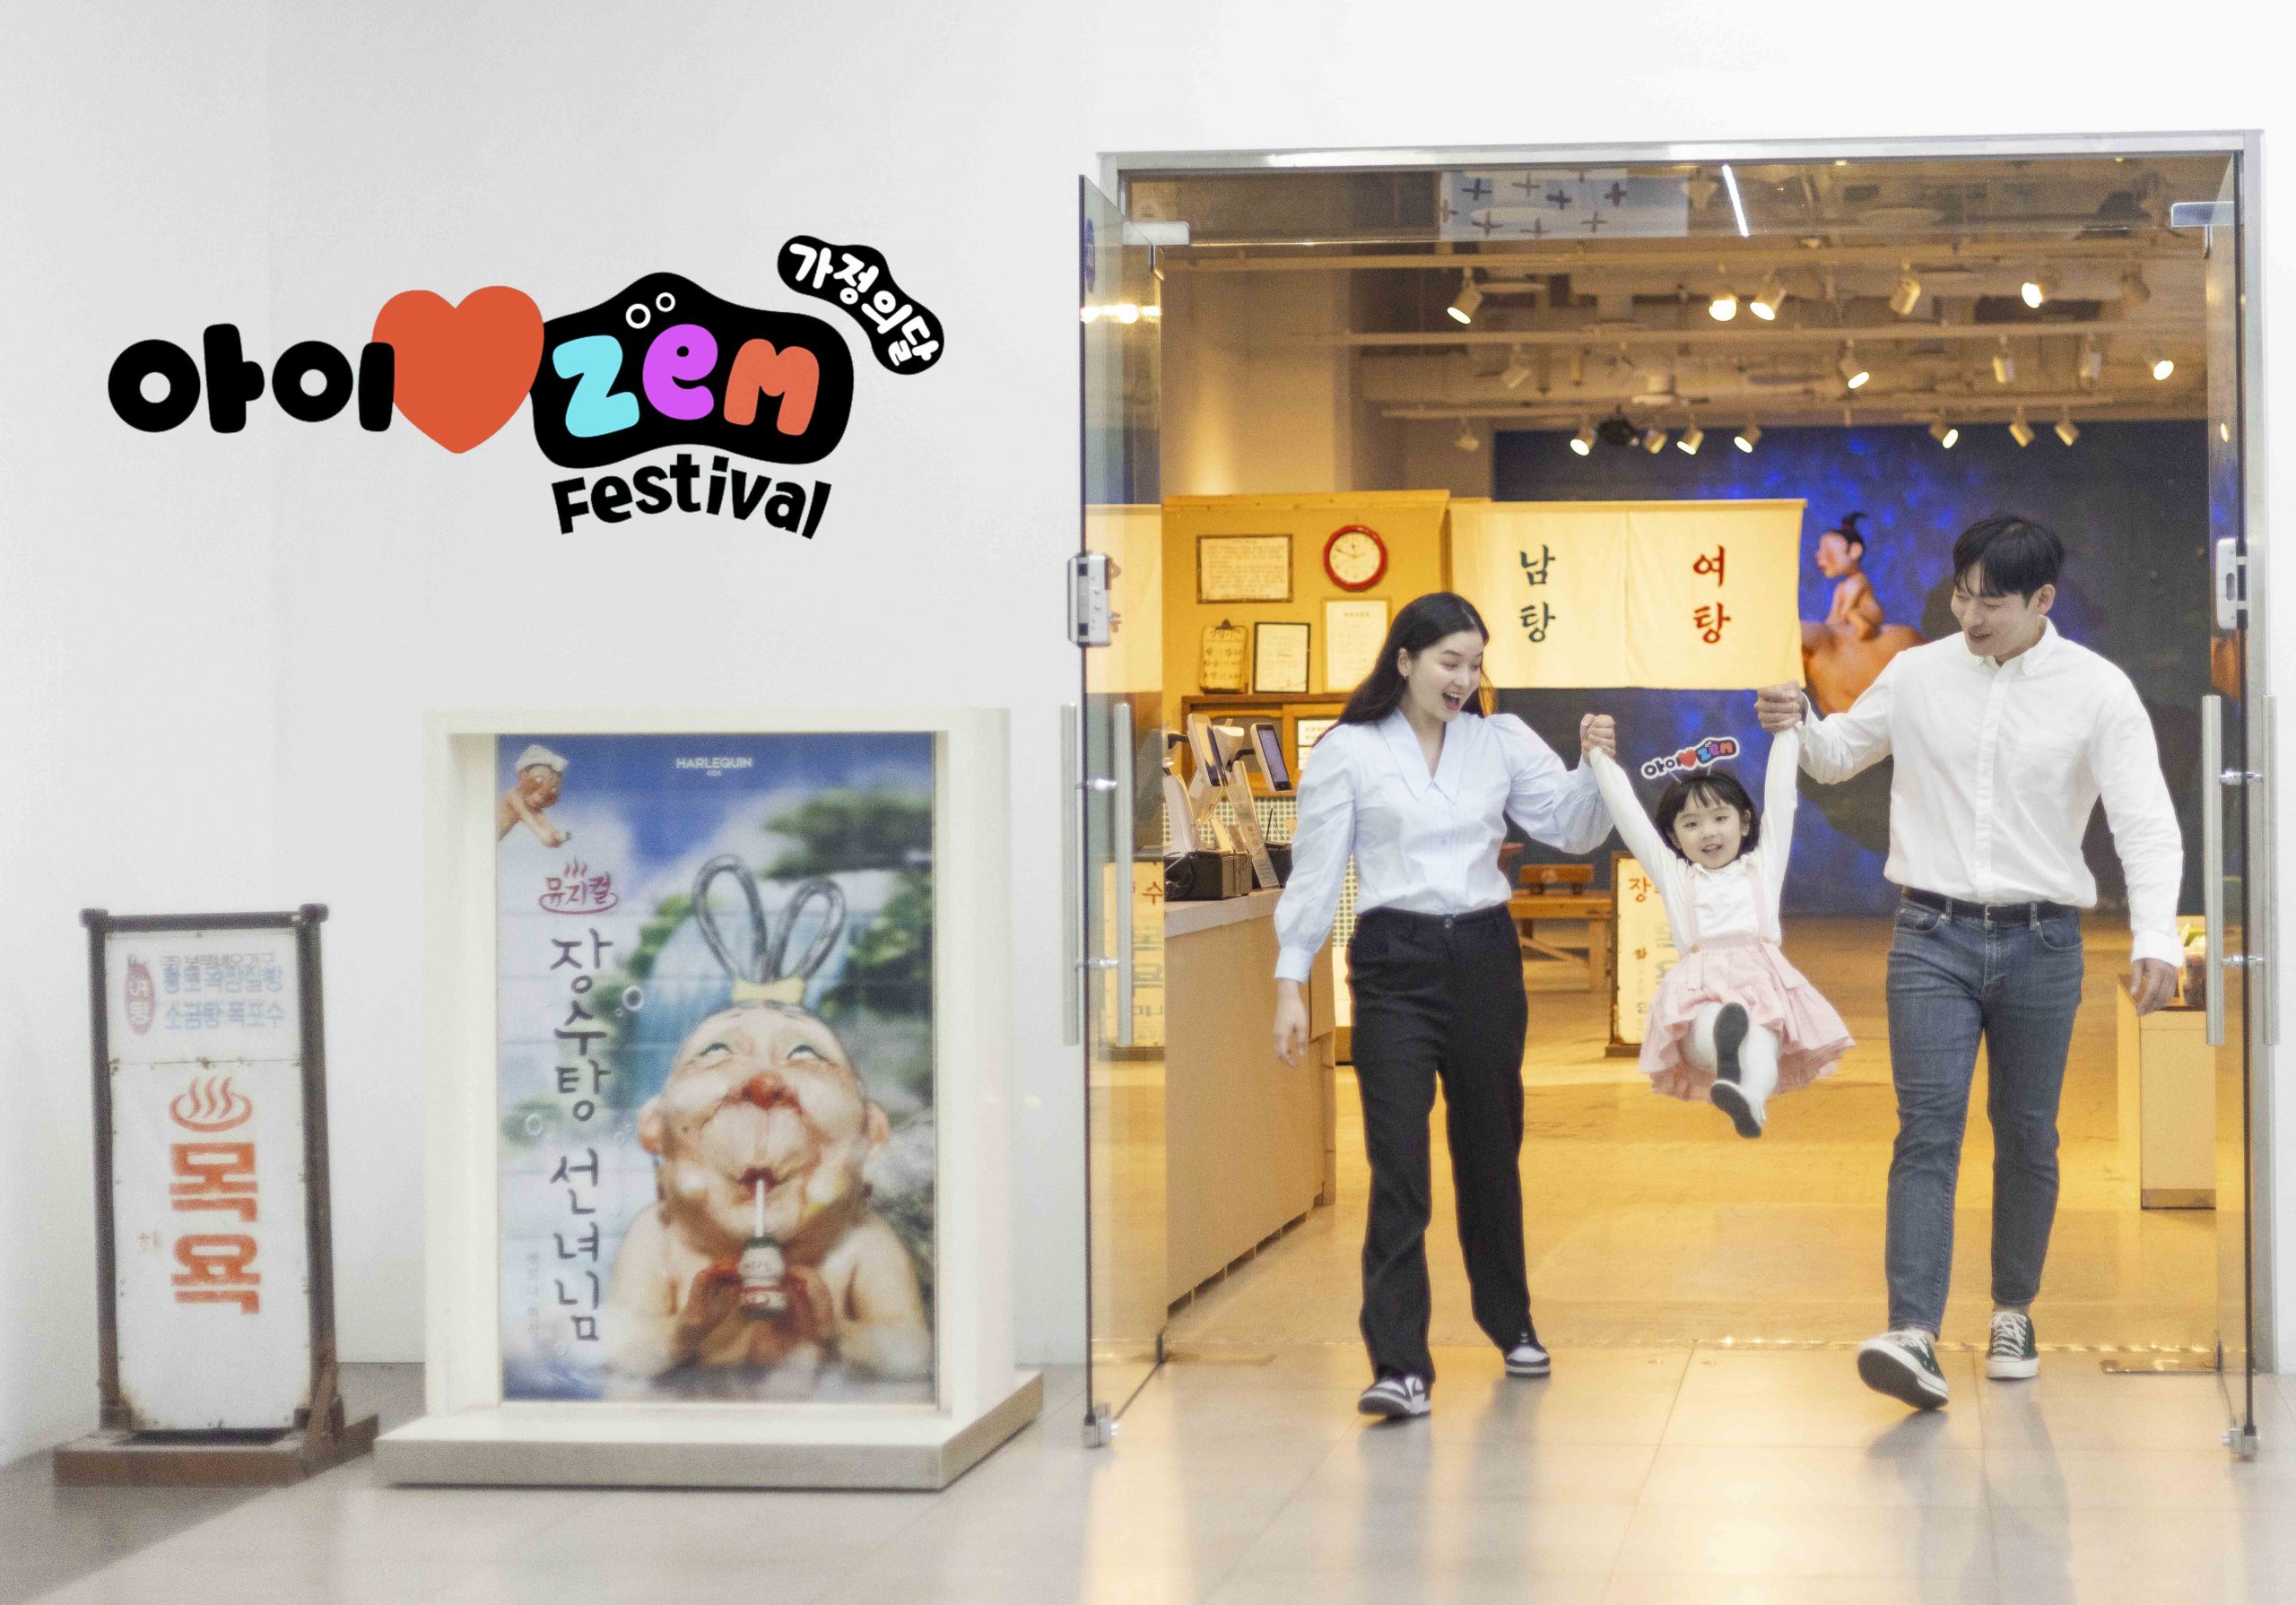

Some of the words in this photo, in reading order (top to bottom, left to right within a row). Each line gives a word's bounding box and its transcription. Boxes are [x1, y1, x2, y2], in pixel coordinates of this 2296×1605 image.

[1519, 543, 1556, 644] 남탕
[1692, 544, 1732, 645] 여탕
[675, 757, 753, 768] HARLEQUIN
[544, 870, 612, 907] 뮤지컬
[550, 927, 613, 1123] 장수탕
[168, 1141, 261, 1314] 목욕
[550, 1146, 600, 1341] 선녀님
